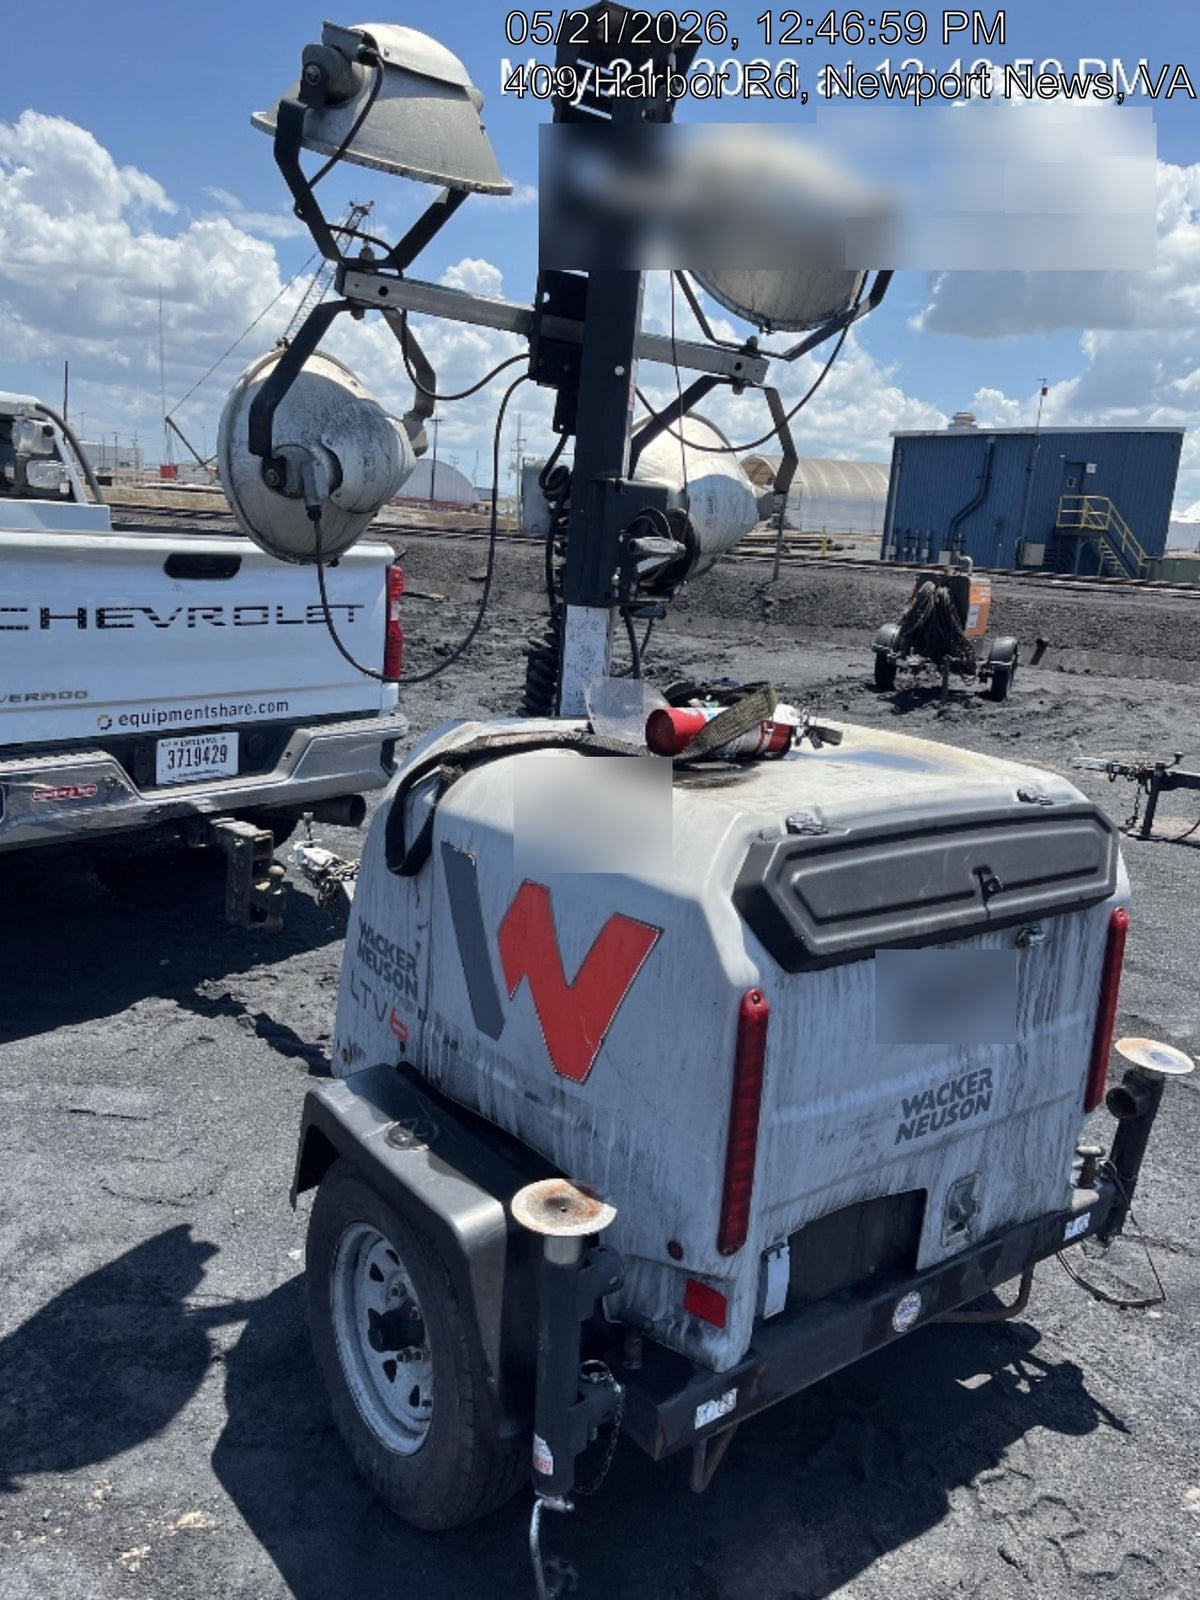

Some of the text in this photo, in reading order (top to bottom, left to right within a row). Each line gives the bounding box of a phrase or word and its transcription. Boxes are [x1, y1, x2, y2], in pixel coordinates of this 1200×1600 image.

[0, 603, 365, 631] CHEVROLET
[117, 700, 290, 728] equipmentshare.com
[167, 744, 229, 770] 3719429
[356, 938, 419, 1001] NEUSON
[357, 915, 419, 979] WACKER
[893, 1089, 994, 1146] NEUSON
[900, 1067, 994, 1120] WACKER
